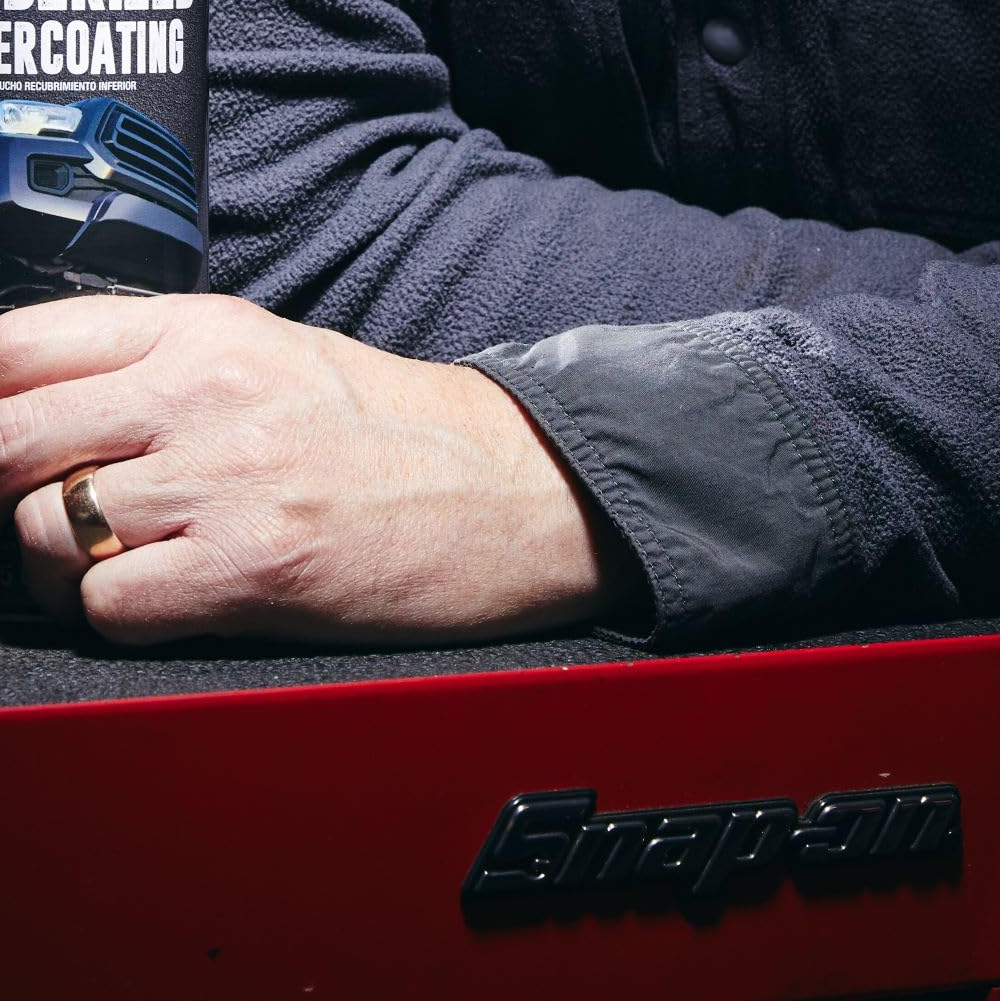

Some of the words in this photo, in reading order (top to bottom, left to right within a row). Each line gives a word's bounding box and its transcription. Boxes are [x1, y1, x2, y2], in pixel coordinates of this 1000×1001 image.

[24, 81, 96, 91] RECUBRIMIENTO
[98, 80, 137, 91] INFERIOR
[465, 786, 959, 900] Snap-on
